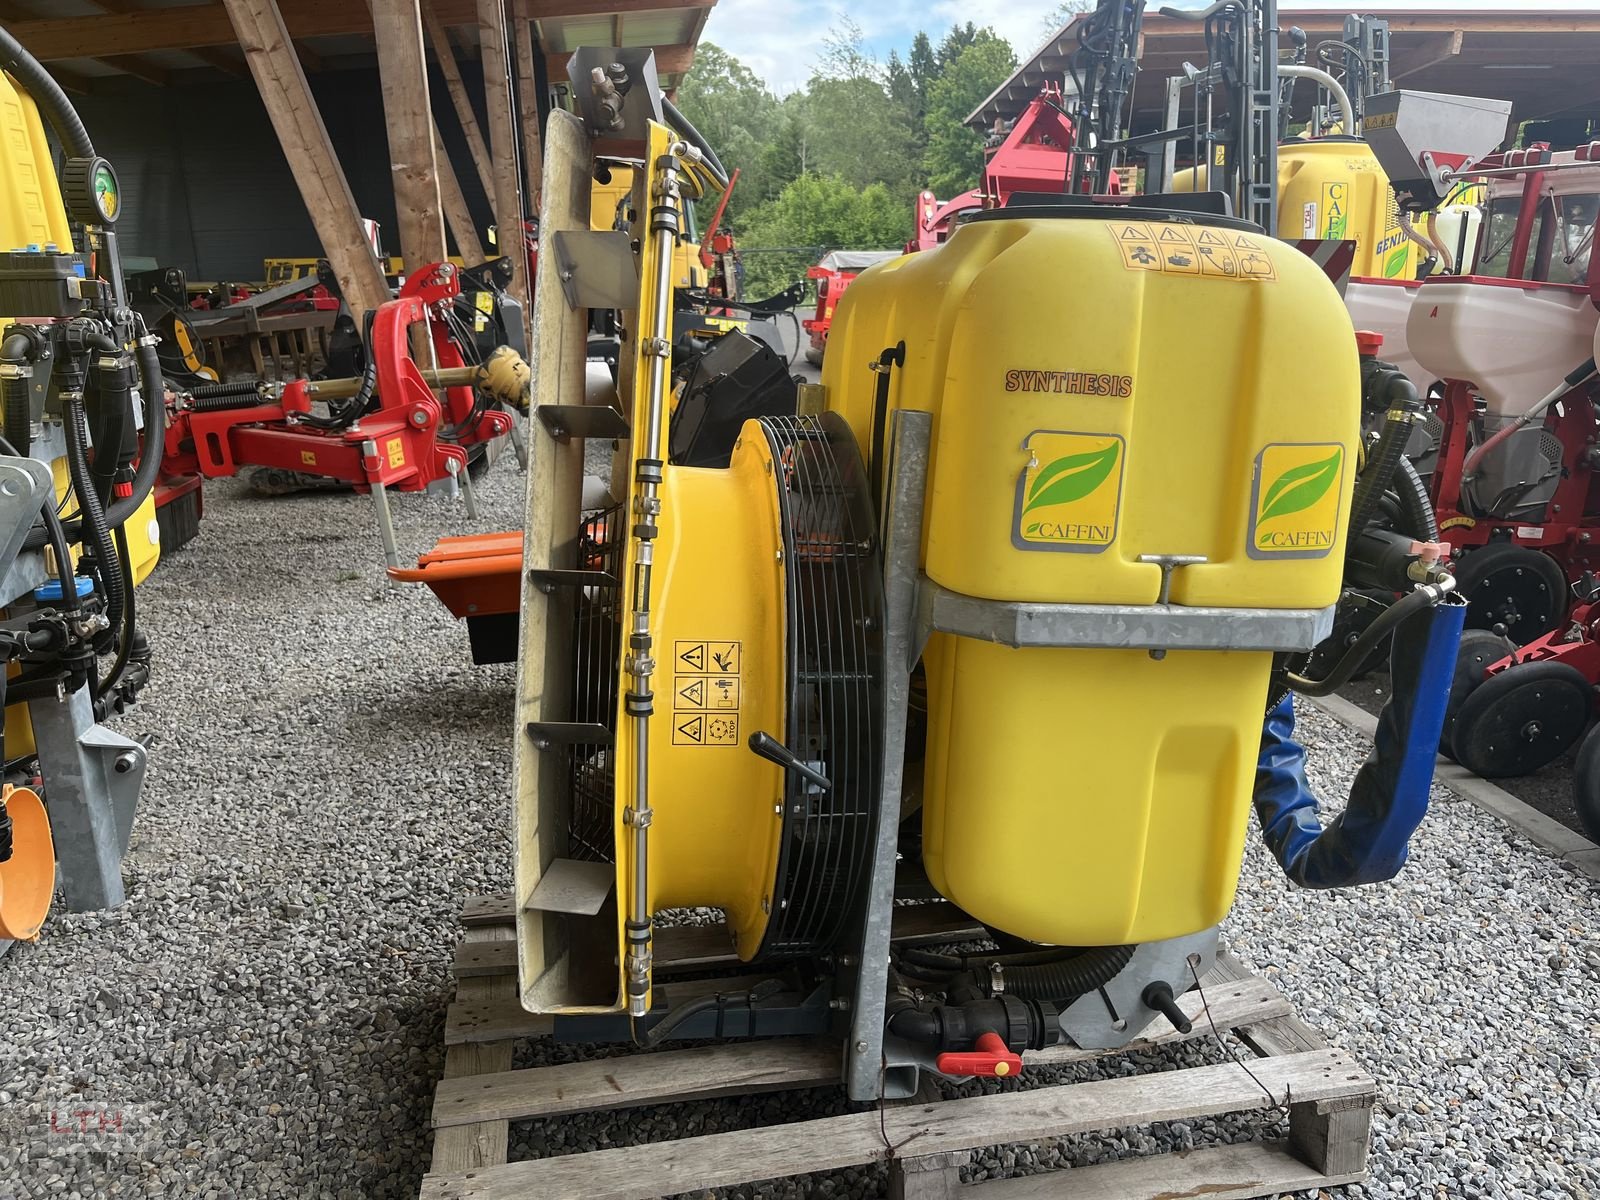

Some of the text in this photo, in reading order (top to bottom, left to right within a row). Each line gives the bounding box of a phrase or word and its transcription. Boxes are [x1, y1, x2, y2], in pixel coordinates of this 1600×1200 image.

[1430, 305, 1438, 318] A
[1005, 370, 1133, 398] SYNTHESIS
[1039, 522, 1111, 540] CAFFINI
[1271, 530, 1332, 546] CAFFINI
